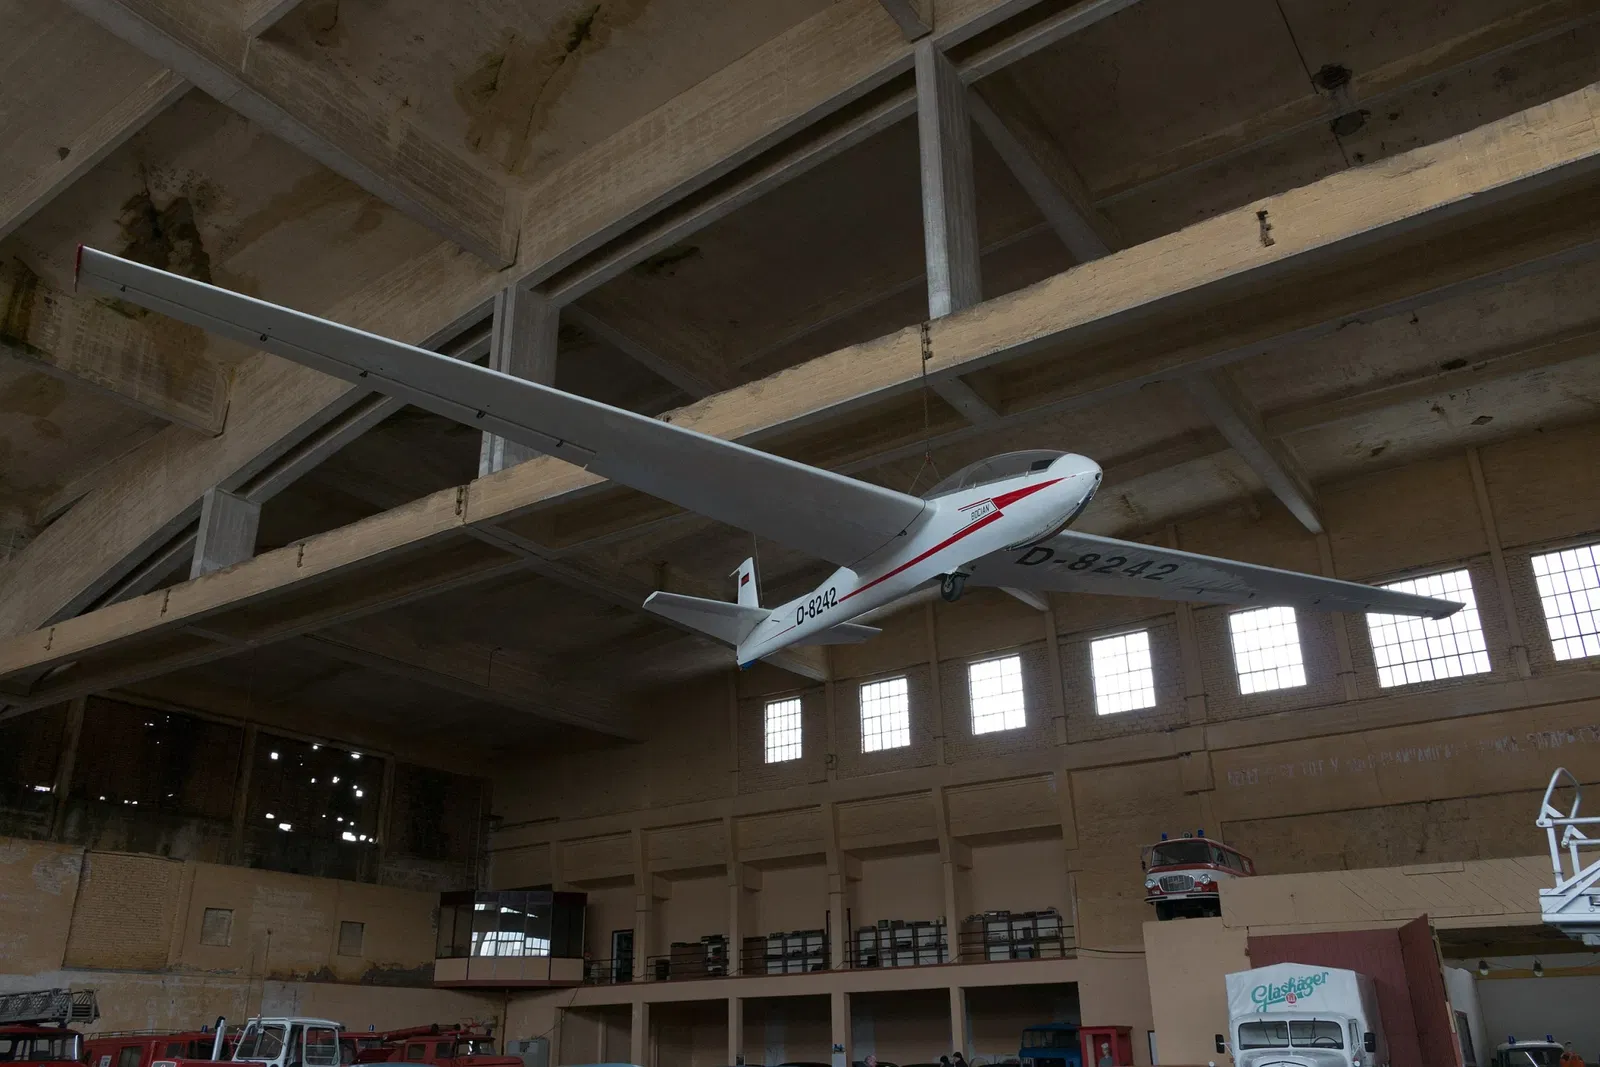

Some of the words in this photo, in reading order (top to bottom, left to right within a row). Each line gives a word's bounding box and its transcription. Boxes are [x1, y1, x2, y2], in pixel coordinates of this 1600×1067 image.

[1014, 546, 1179, 581] D-8242
[796, 586, 838, 626] D-8242
[1251, 971, 1329, 1013] Glashäger
